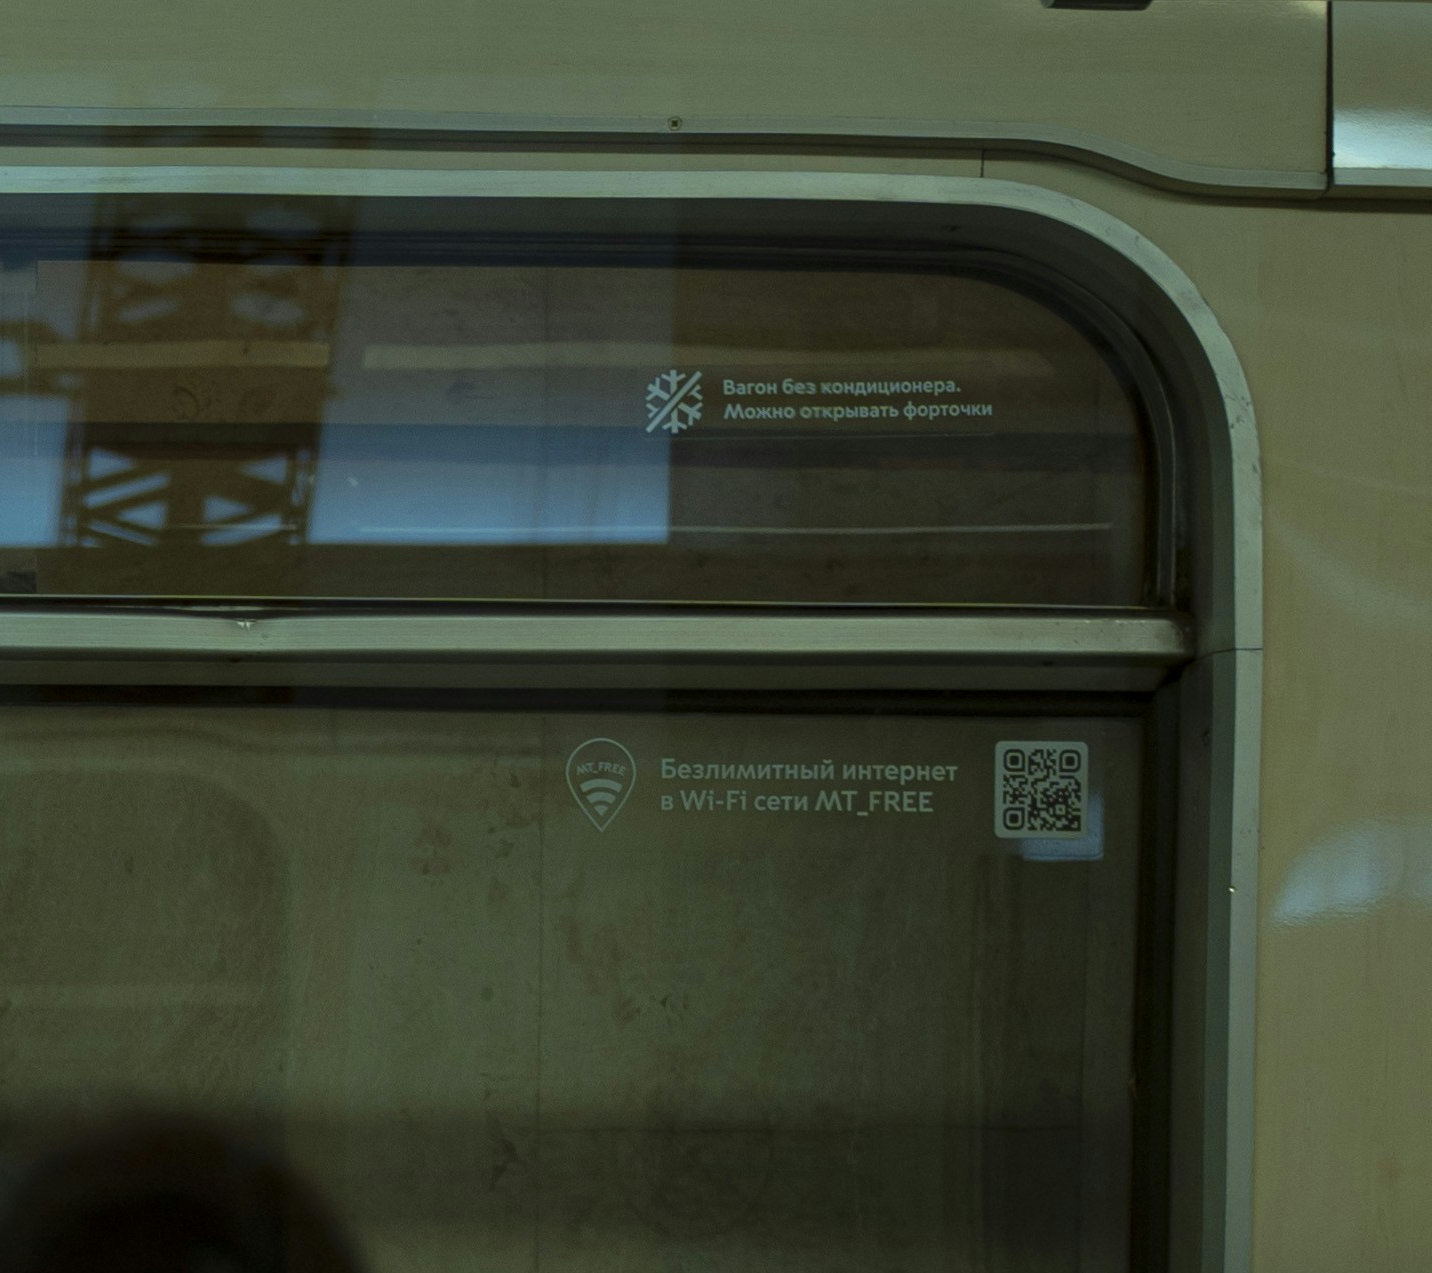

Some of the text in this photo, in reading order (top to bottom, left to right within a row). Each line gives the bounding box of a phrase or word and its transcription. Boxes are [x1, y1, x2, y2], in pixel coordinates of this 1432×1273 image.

[723, 379, 961, 397] Вагон без кондиционера.
[723, 401, 993, 421] Можно открывать форточки
[576, 761, 626, 776] MT_FREE
[661, 758, 958, 785] Безлимитный интернет
[661, 789, 934, 817] в Wi-Fi сети MT_FREE
